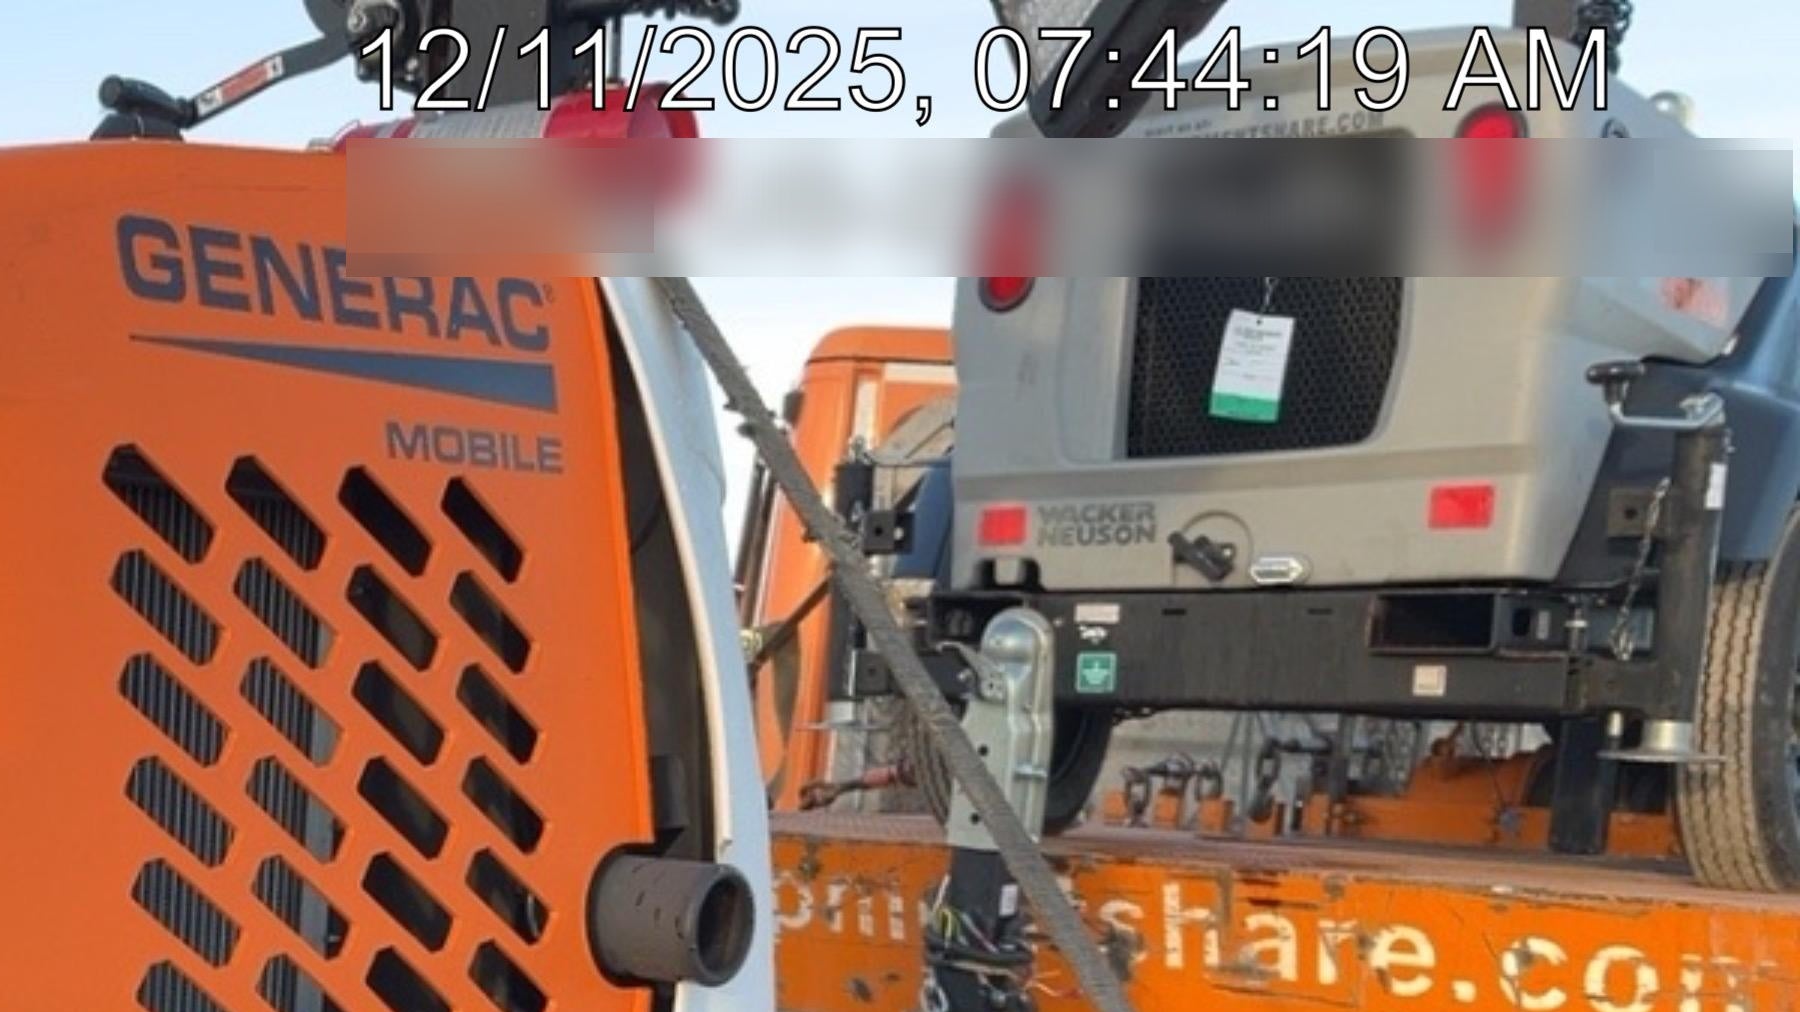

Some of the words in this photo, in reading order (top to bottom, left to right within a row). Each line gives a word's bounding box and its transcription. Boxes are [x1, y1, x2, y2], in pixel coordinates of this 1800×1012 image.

[115, 213, 552, 353] GENERAC
[385, 421, 564, 474] MOBILE
[1037, 502, 1157, 525] WACKER
[1037, 522, 1157, 547] NEUSON
